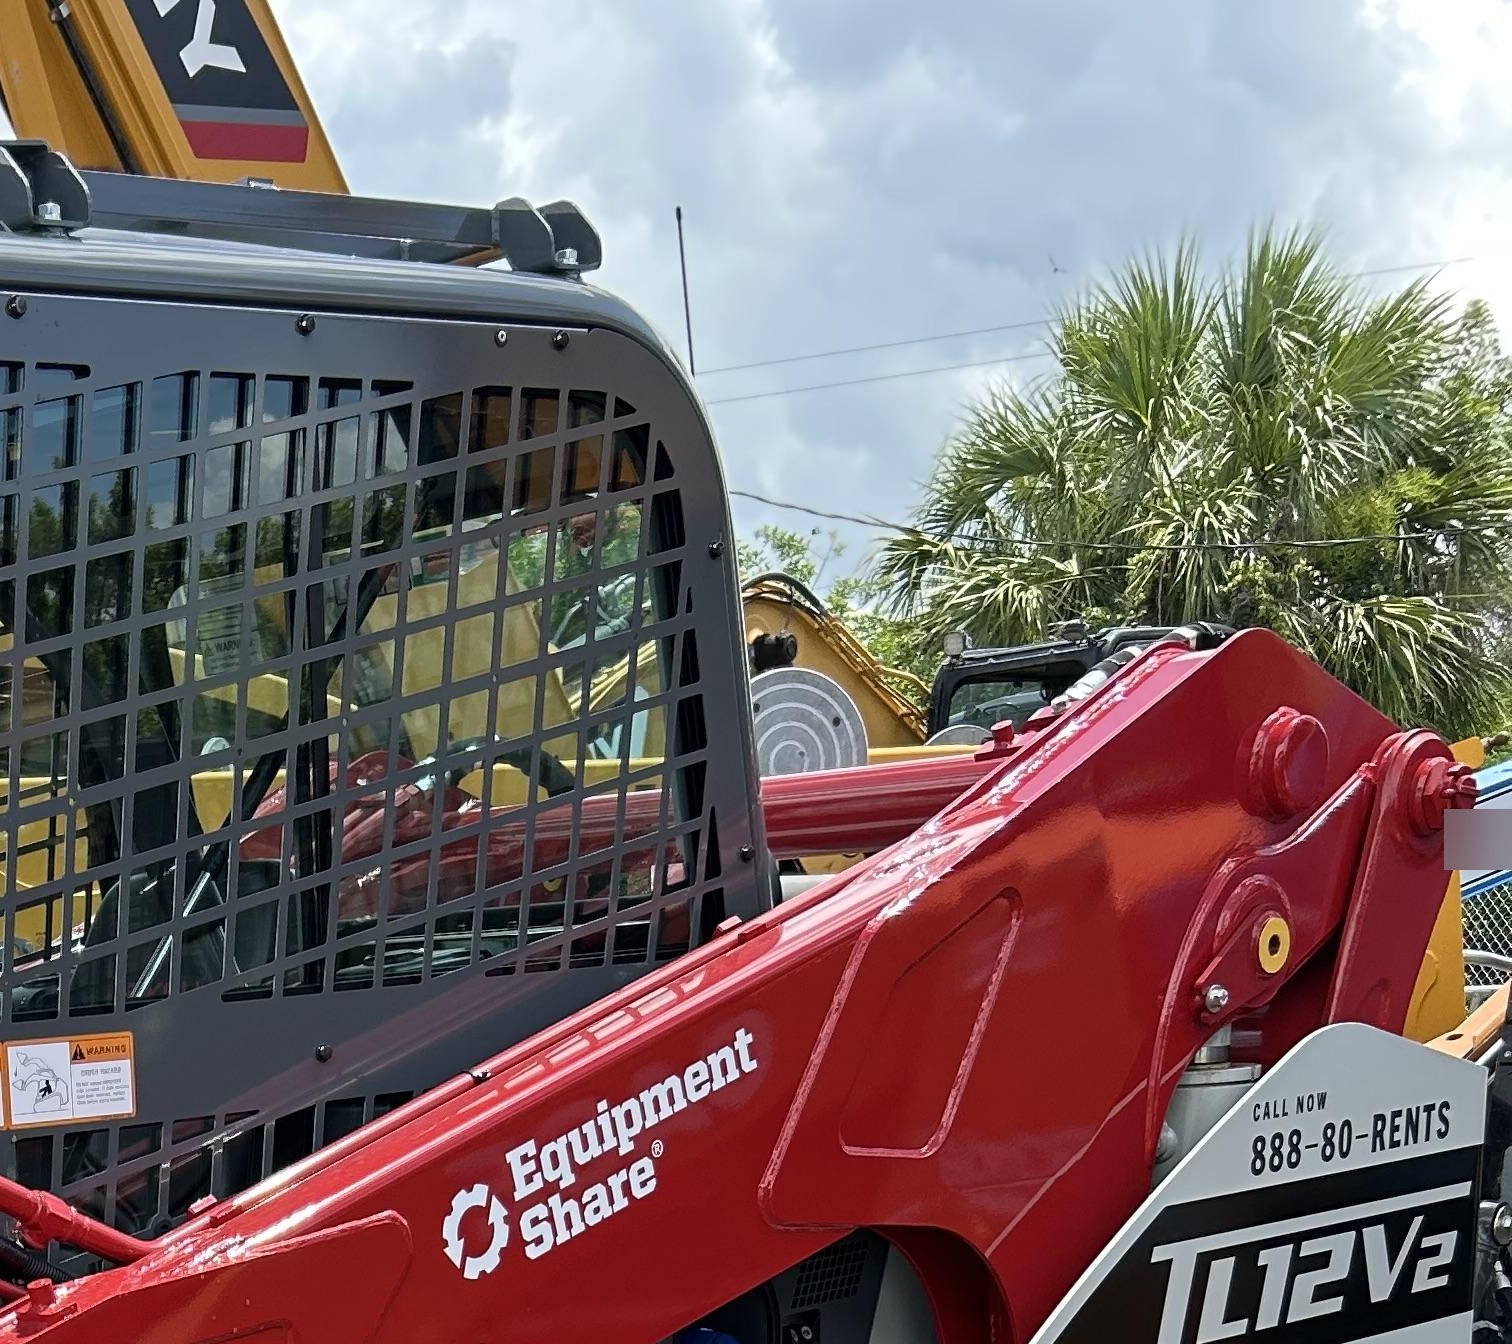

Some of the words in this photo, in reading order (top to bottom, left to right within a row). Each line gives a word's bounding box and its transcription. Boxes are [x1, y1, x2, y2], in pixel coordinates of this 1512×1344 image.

[86, 1044, 126, 1056] WARNING
[505, 1027, 758, 1202] Equipment
[1253, 1098, 1289, 1122] CALL
[1295, 1091, 1328, 1114] NOW
[1250, 1100, 1451, 1176] 888-80-RENTS
